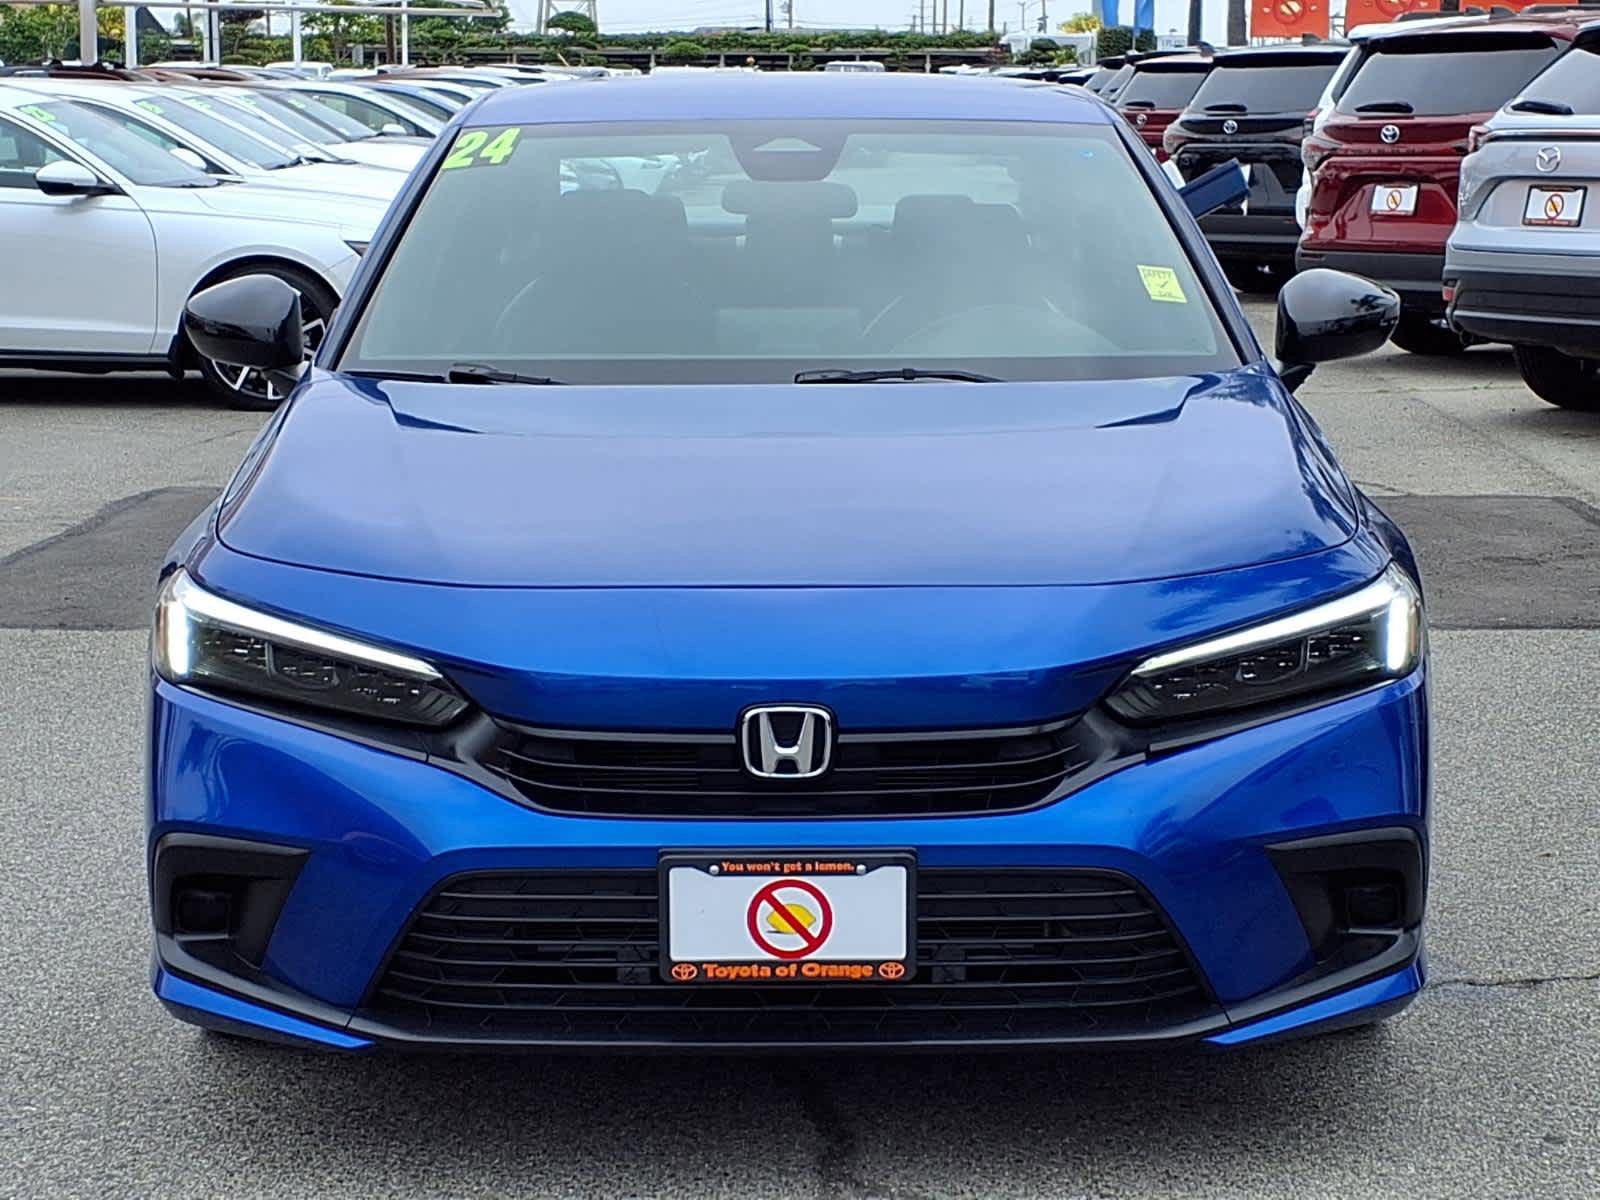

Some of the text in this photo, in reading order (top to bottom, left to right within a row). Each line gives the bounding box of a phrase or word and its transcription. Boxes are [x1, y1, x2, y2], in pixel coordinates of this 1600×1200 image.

[441, 127, 521, 169] 24
[722, 861, 744, 872] You
[746, 861, 781, 872] won't
[805, 863, 812, 872] a
[815, 861, 855, 872] lemon.
[702, 962, 874, 979] Toyota of Orange
